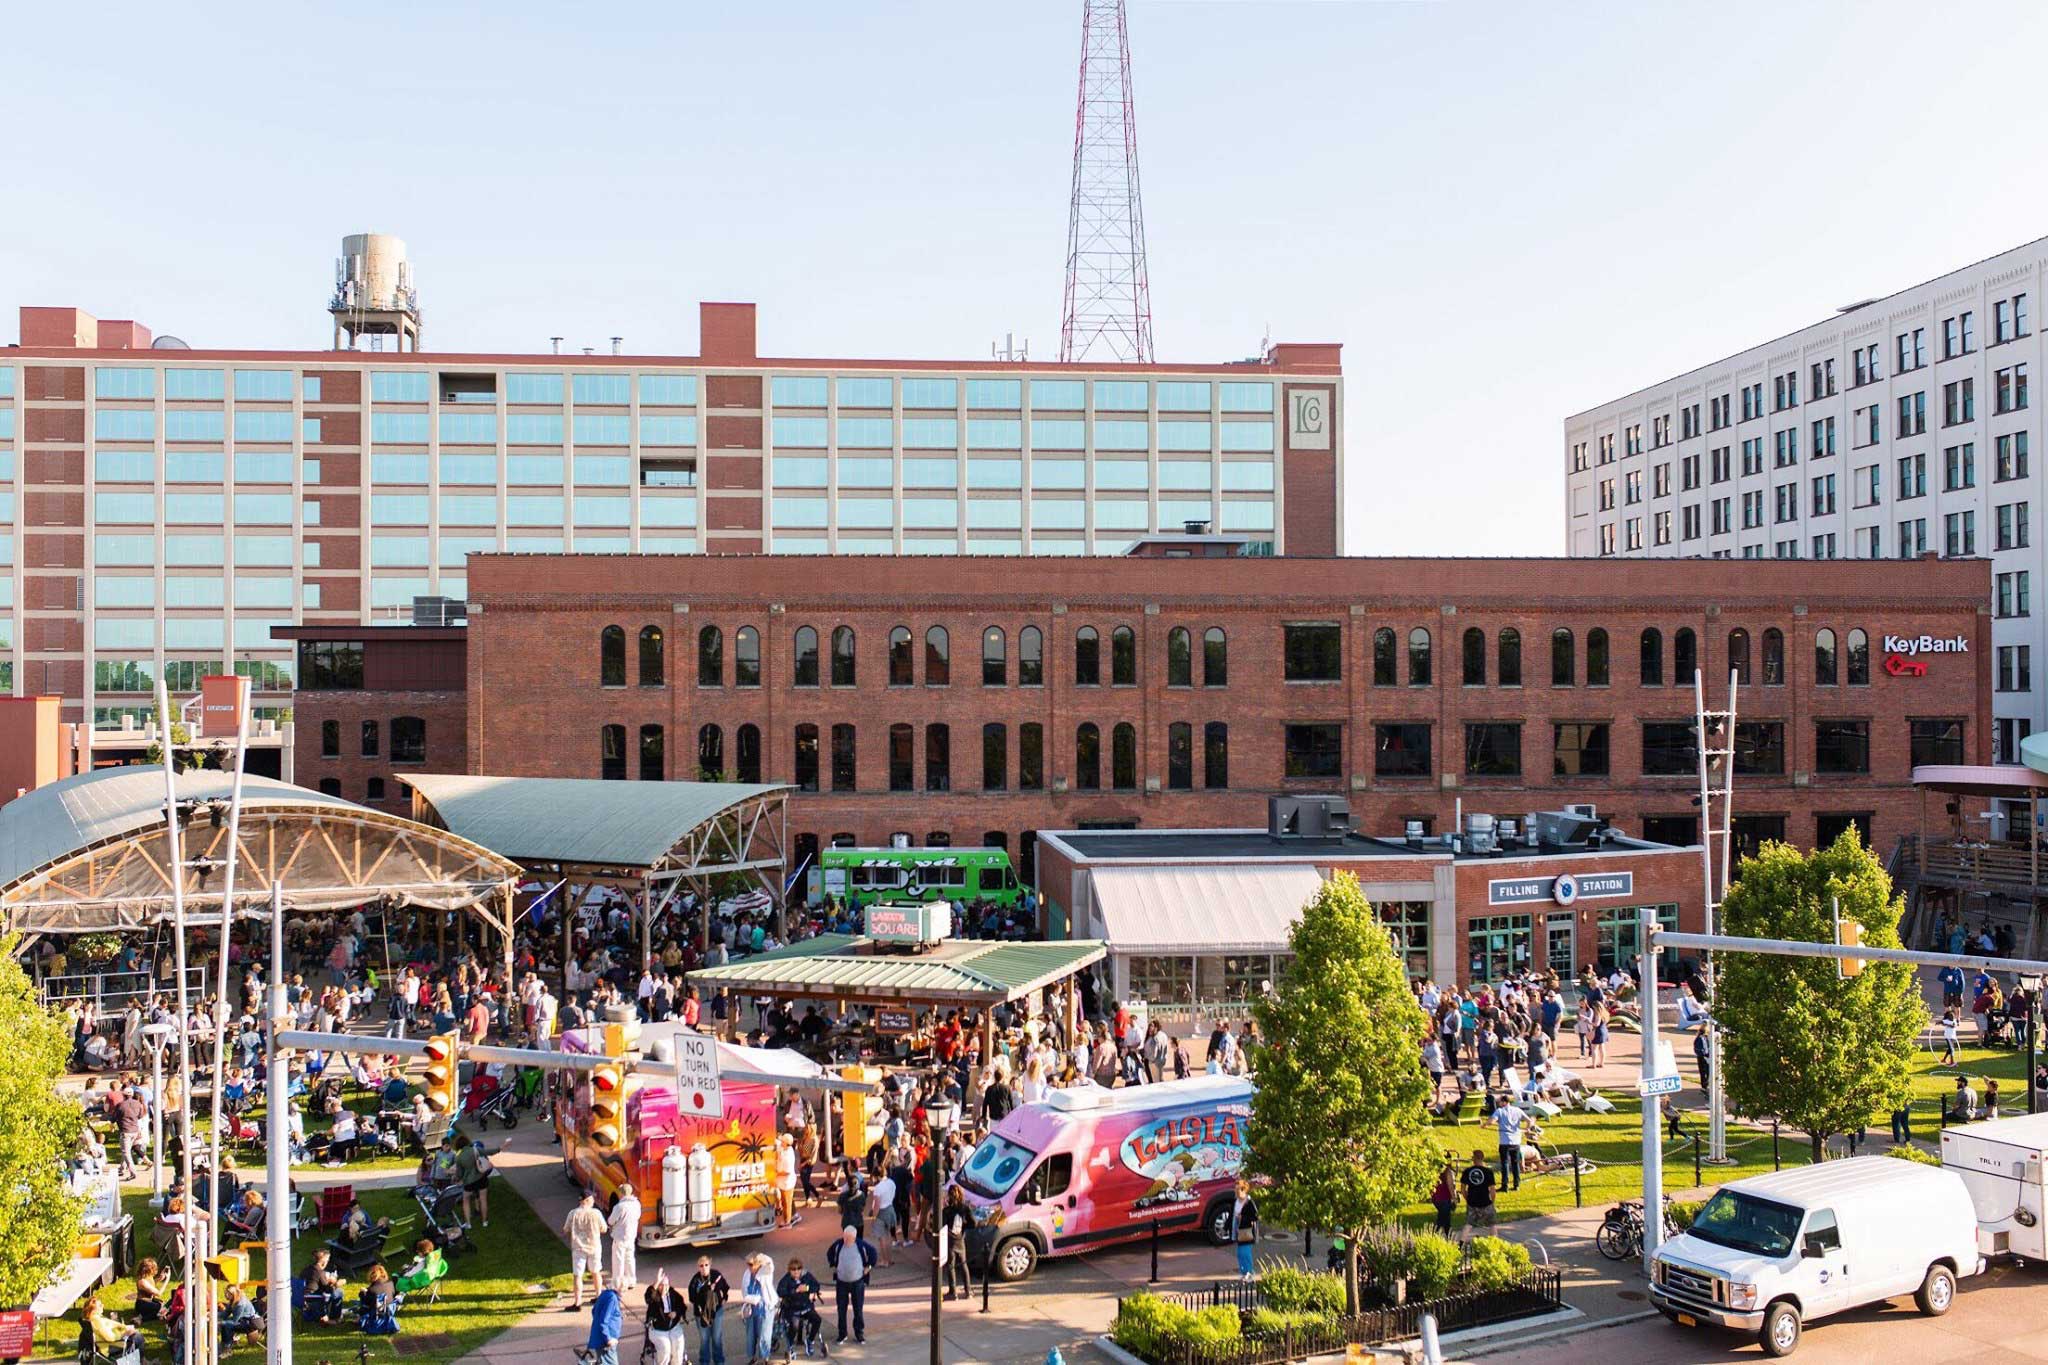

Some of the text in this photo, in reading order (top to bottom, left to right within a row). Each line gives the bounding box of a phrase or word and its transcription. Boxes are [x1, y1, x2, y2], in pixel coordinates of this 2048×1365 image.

[1884, 635, 1968, 656] KeyBank
[1499, 879, 1623, 897] FILLING STATION
[871, 922, 918, 936] SQUARE
[686, 1041, 704, 1056] NO
[685, 1059, 709, 1073] TURN
[681, 1075, 716, 1091] ON RED
[1648, 1078, 1676, 1092] SENECA
[662, 1104, 759, 1134] HAIAN
[697, 1120, 725, 1136] BBQ
